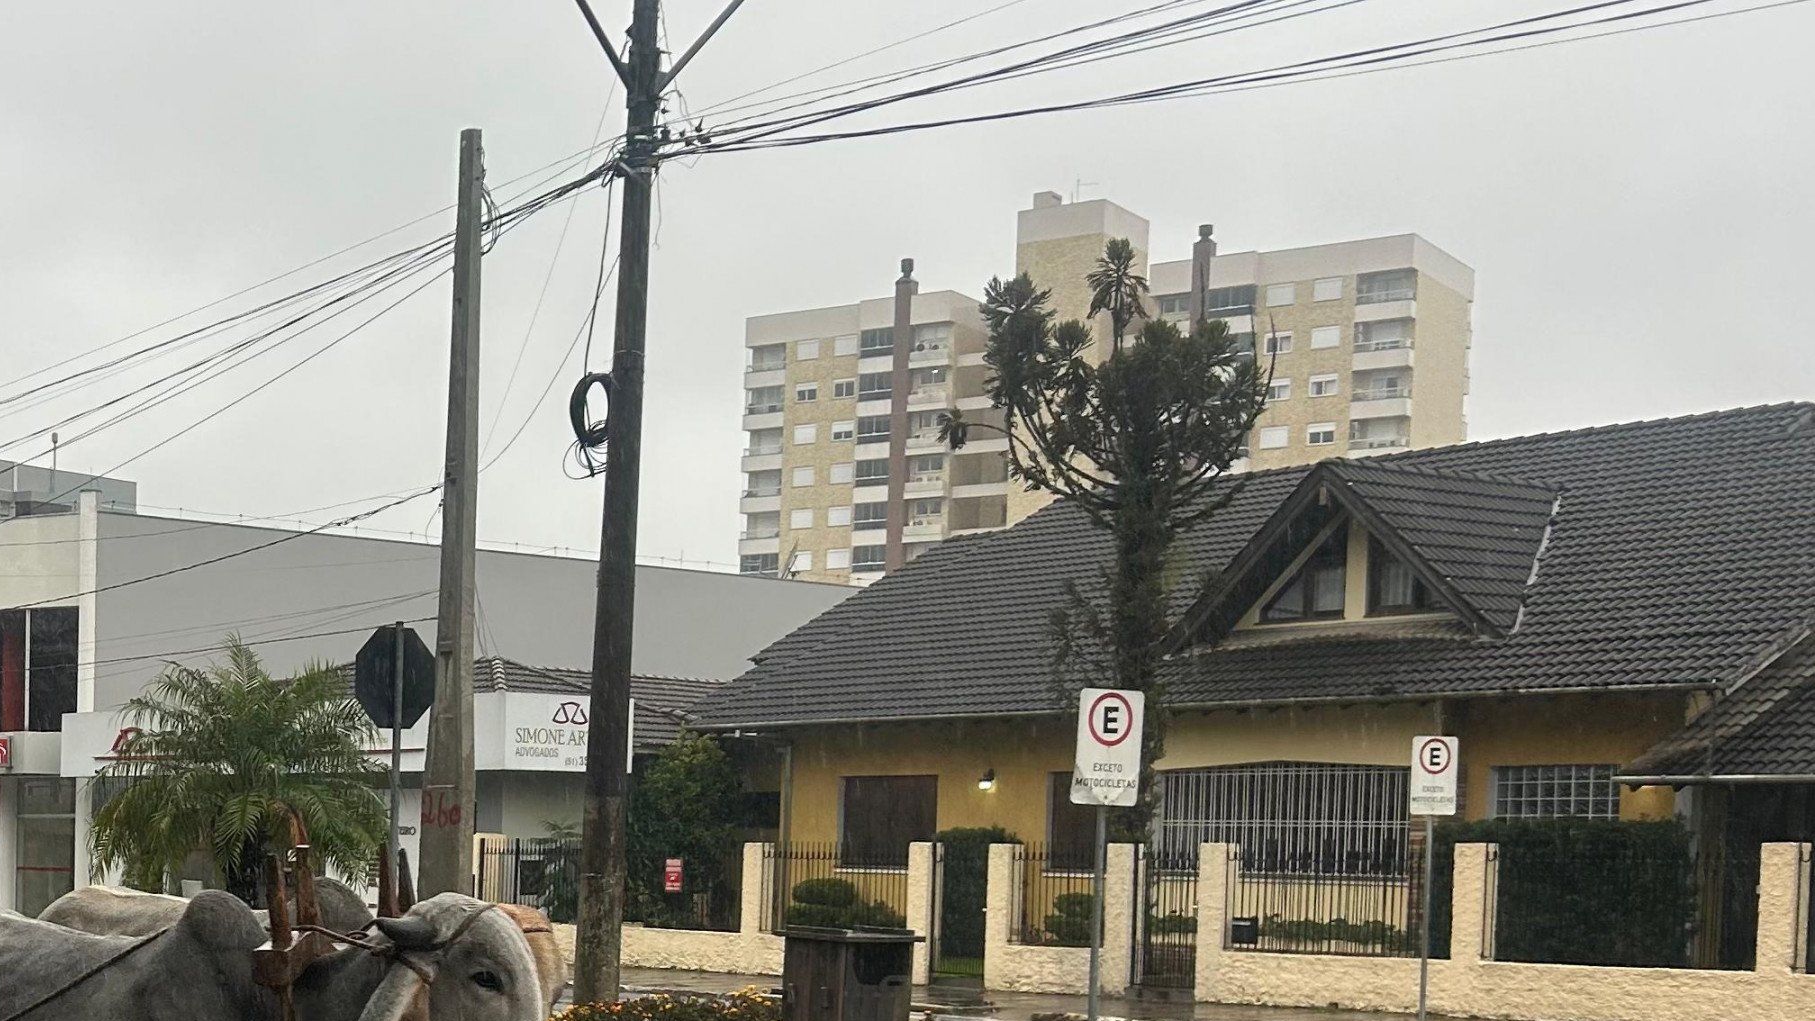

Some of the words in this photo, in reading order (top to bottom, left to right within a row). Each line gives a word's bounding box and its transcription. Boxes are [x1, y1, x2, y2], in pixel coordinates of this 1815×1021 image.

[1103, 706, 1119, 733] E
[515, 727, 565, 745] SIMONE
[566, 729, 589, 746] AR
[515, 746, 559, 758] ADVOGADOS
[1429, 747, 1441, 766] E
[1093, 762, 1122, 773] EXCETO
[1074, 777, 1136, 789] MOTOCICLETAS
[422, 791, 461, 828] 260
